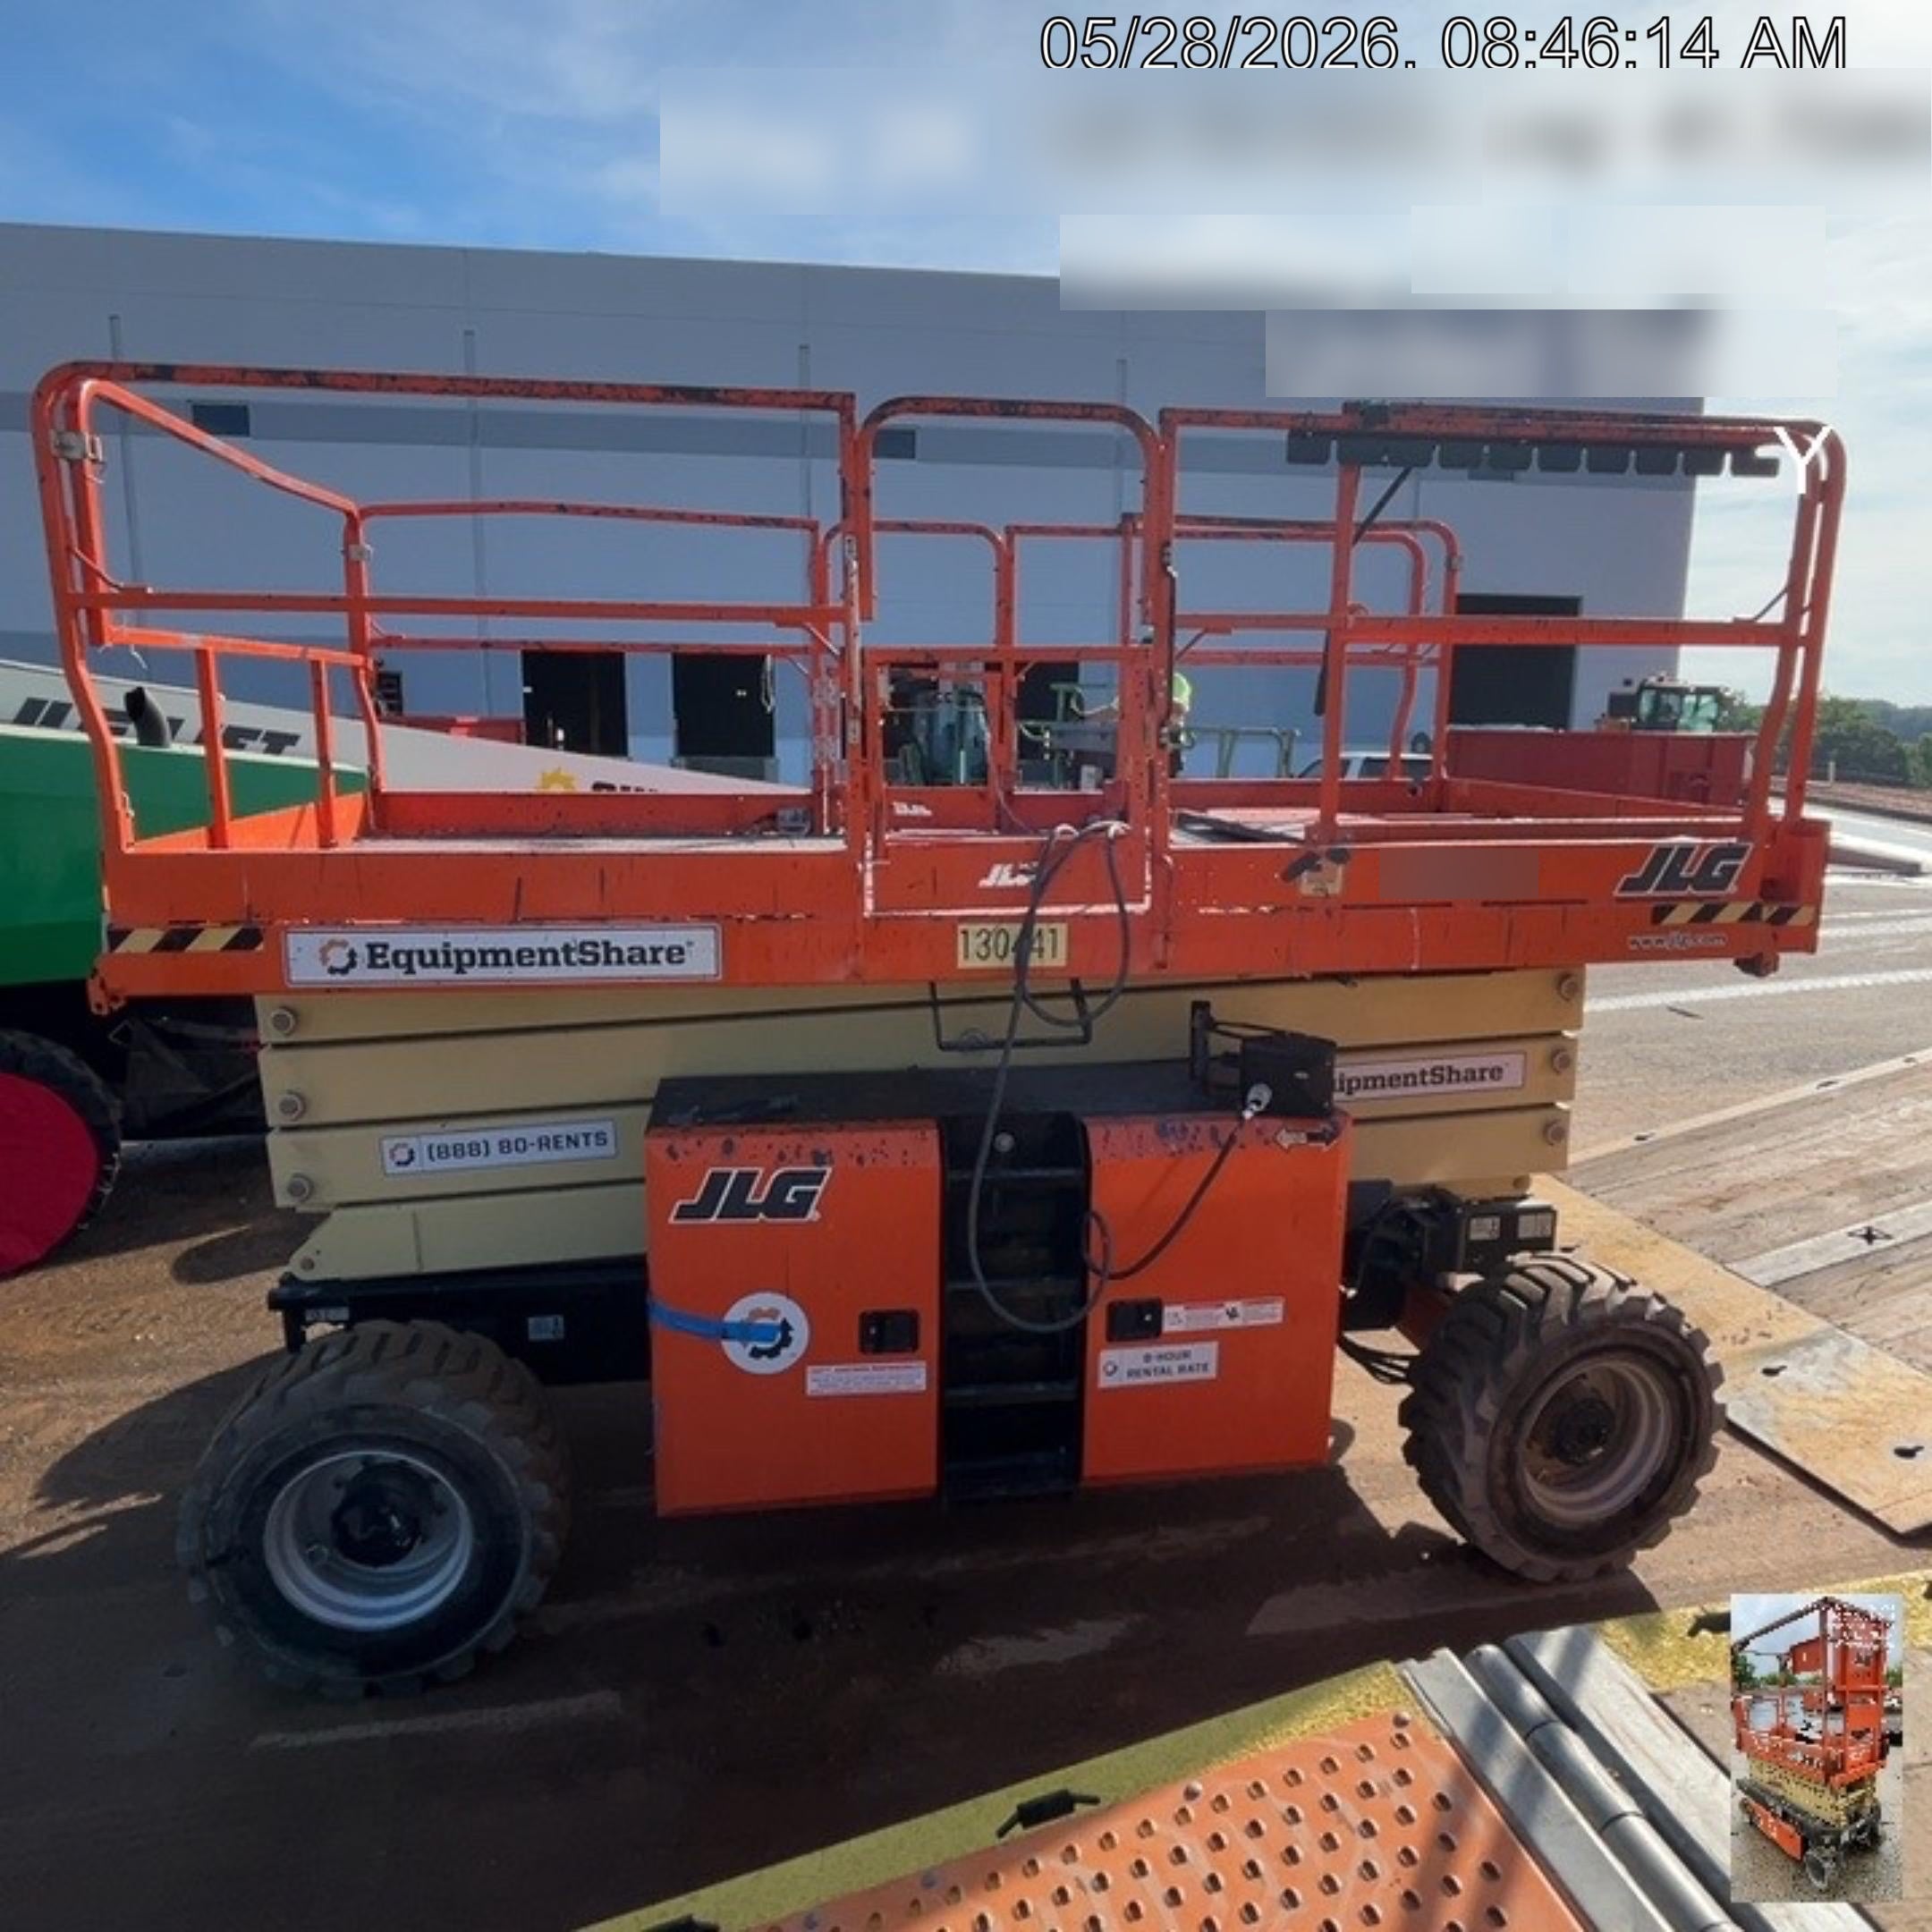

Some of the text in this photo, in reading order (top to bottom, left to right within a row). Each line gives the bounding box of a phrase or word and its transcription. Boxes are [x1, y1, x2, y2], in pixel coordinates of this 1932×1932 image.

[1613, 843, 1754, 896] JLG
[366, 939, 687, 975] EquipmentShare
[961, 928, 1058, 961] 13041
[427, 1130, 609, 1162] (888) 80-RENTS
[668, 1167, 832, 1224] JLG
